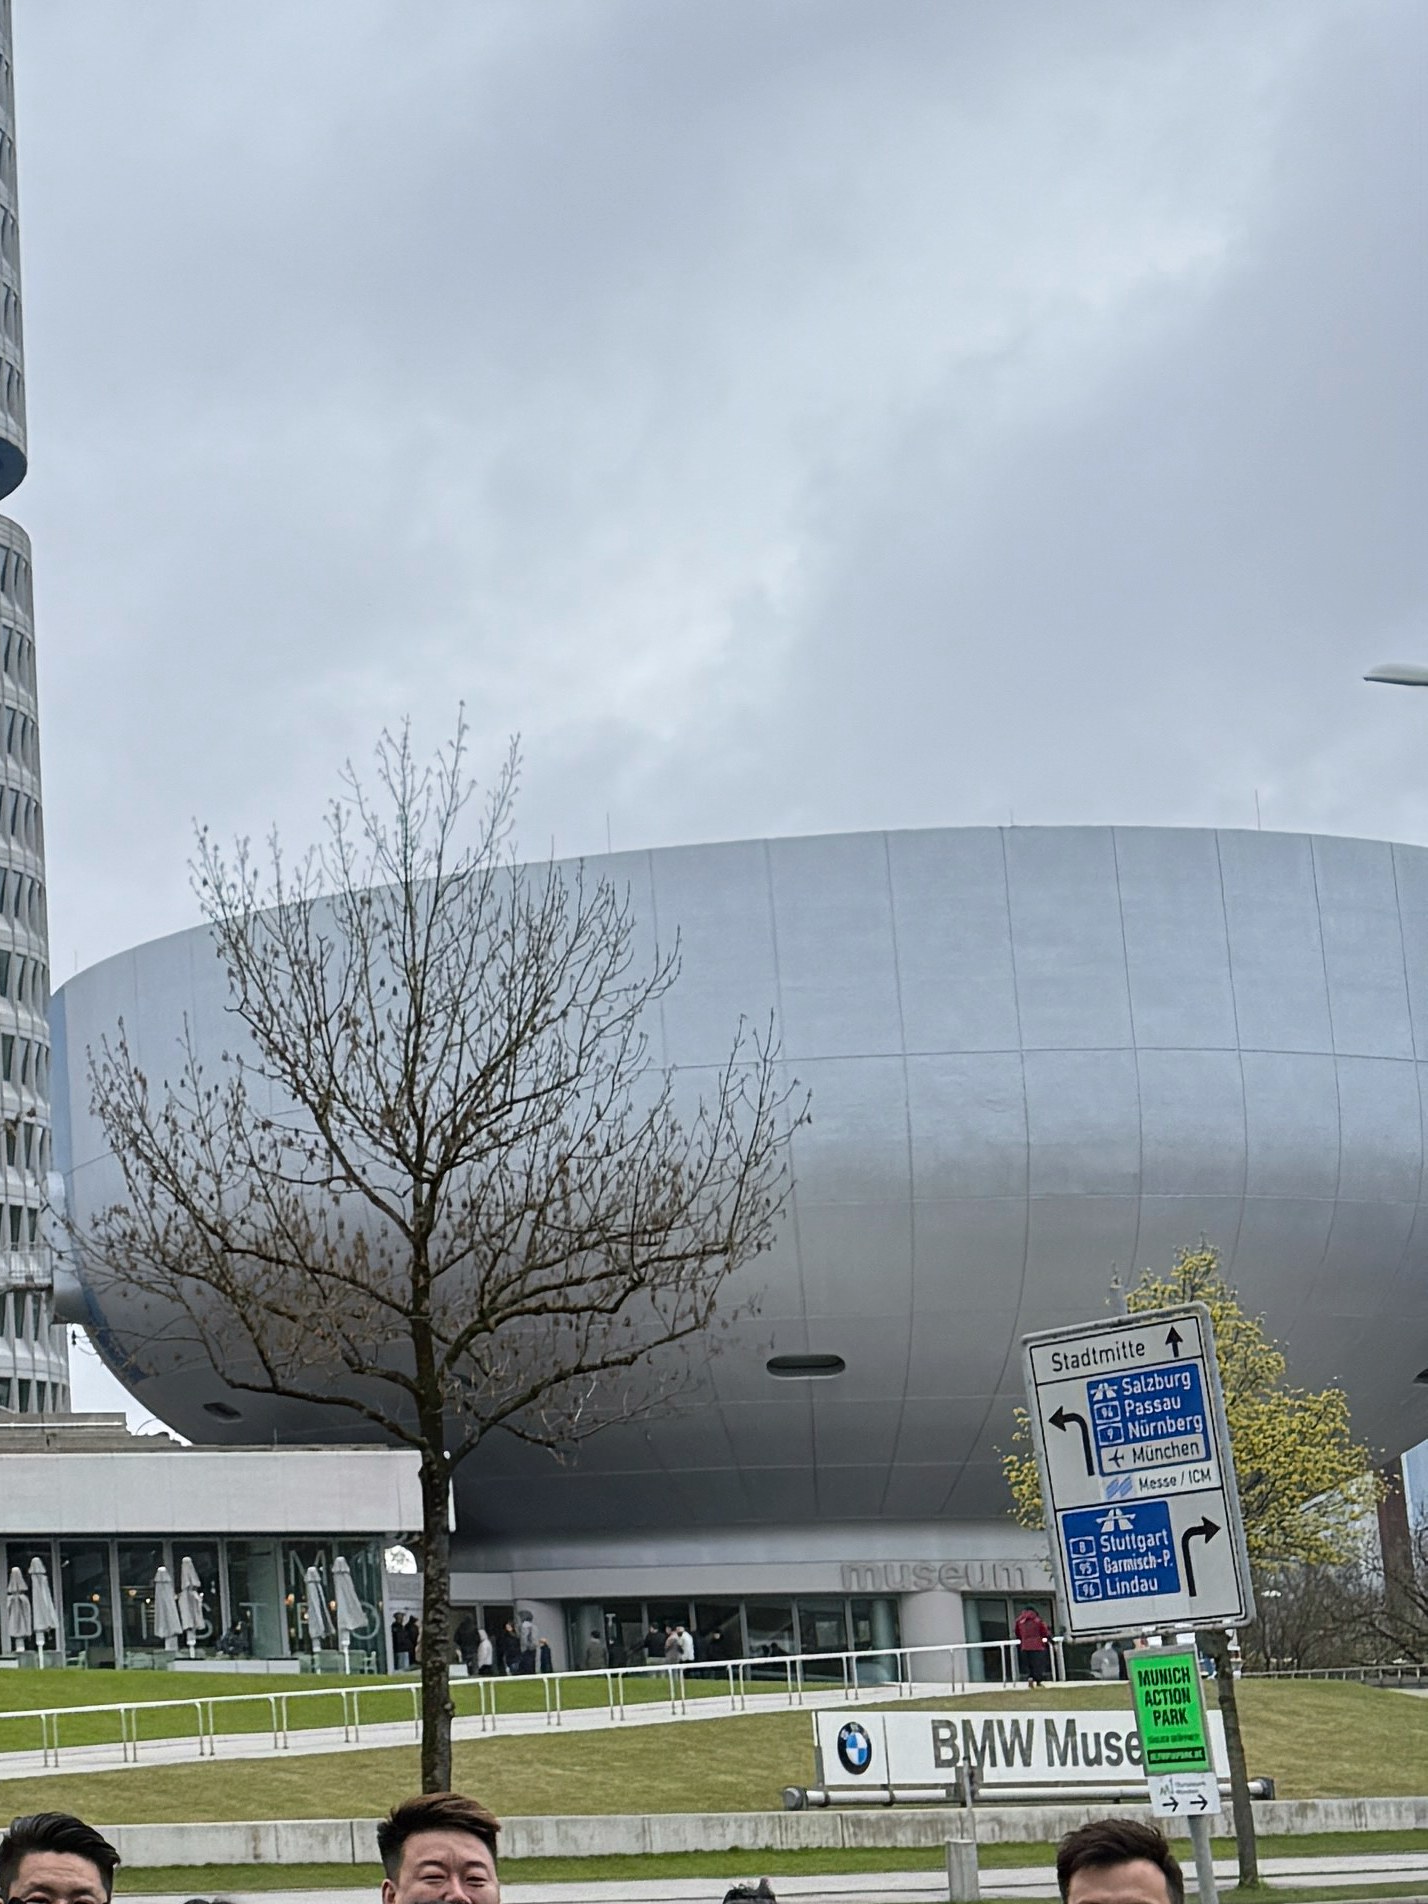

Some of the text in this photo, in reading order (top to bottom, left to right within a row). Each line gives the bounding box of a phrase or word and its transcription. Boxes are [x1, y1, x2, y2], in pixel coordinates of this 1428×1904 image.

[1051, 1340, 1145, 1373] Stadtmitte
[1121, 1371, 1191, 1396] Salzburg
[1124, 1395, 1181, 1417] Passau
[1106, 1415, 1203, 1439] 9 Nürnberg
[1132, 1441, 1200, 1464] München
[1138, 1476, 1177, 1492] Messe
[1188, 1468, 1212, 1484] ICM
[1079, 1529, 1169, 1553] 8 Stuttgart
[1103, 1549, 1174, 1575] Garmisch-P.
[841, 1560, 1025, 1592] museum
[1106, 1575, 1158, 1596] Lindau
[1137, 1666, 1191, 1688] MUNICH
[1144, 1687, 1191, 1707] ACTION
[1152, 1707, 1188, 1727] PARK
[930, 1718, 1034, 1769] BMW
